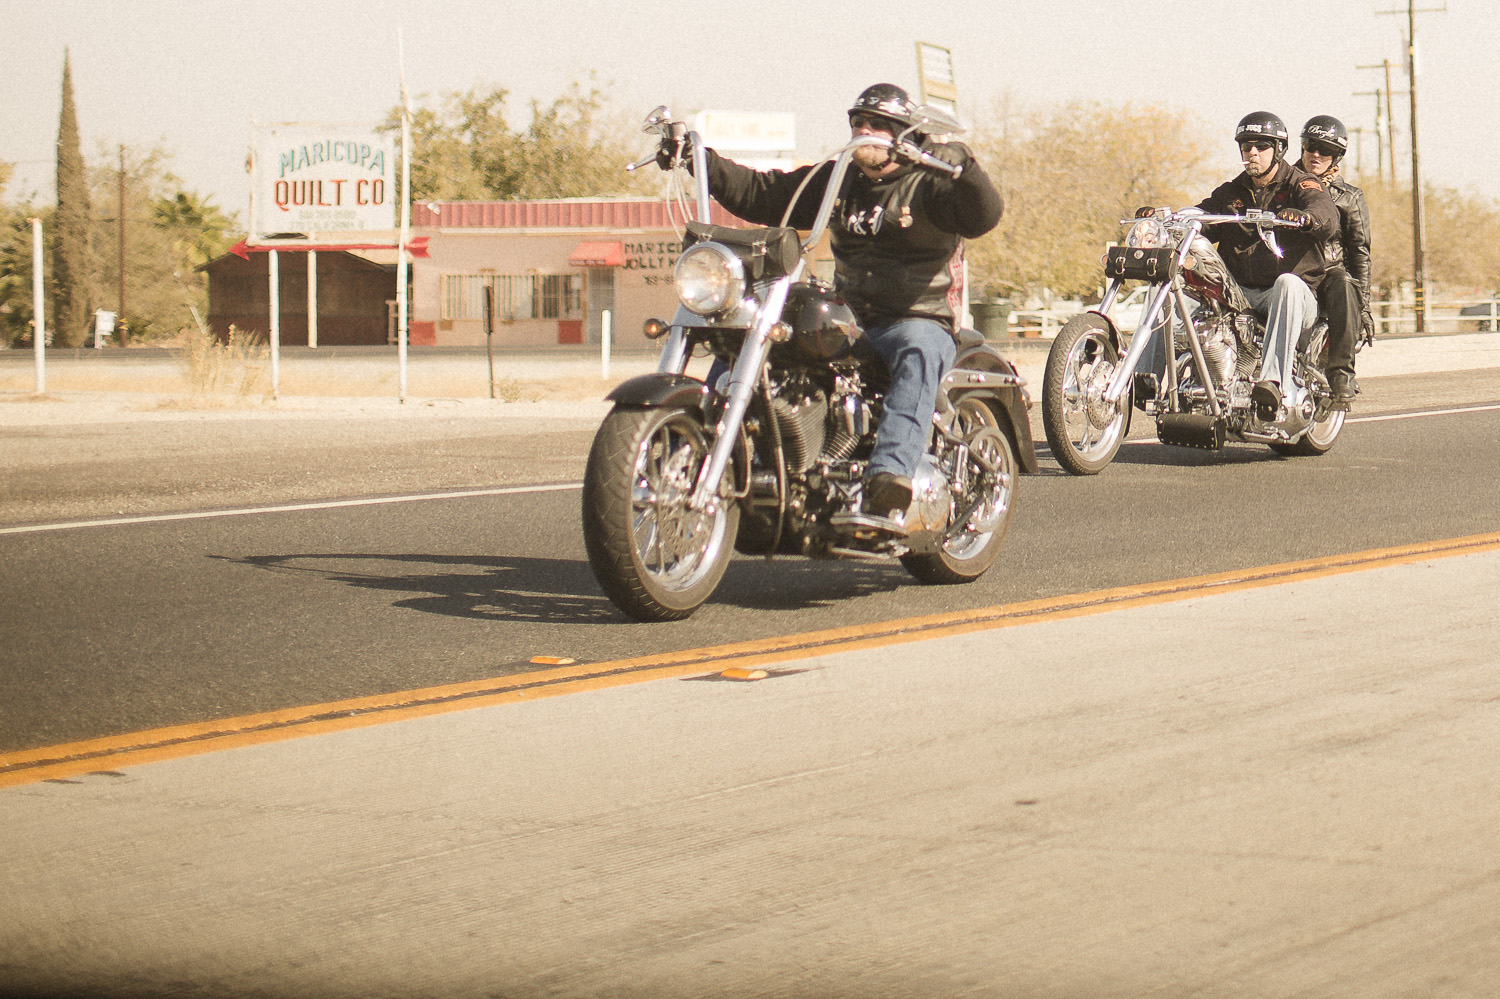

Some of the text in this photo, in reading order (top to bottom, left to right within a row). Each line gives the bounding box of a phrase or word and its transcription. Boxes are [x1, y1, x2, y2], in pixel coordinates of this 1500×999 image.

[278, 140, 385, 178] MARICOPA
[274, 179, 385, 212] QUILT CO
[624, 242, 682, 254] MARICO
[622, 257, 664, 270] JOLLY
